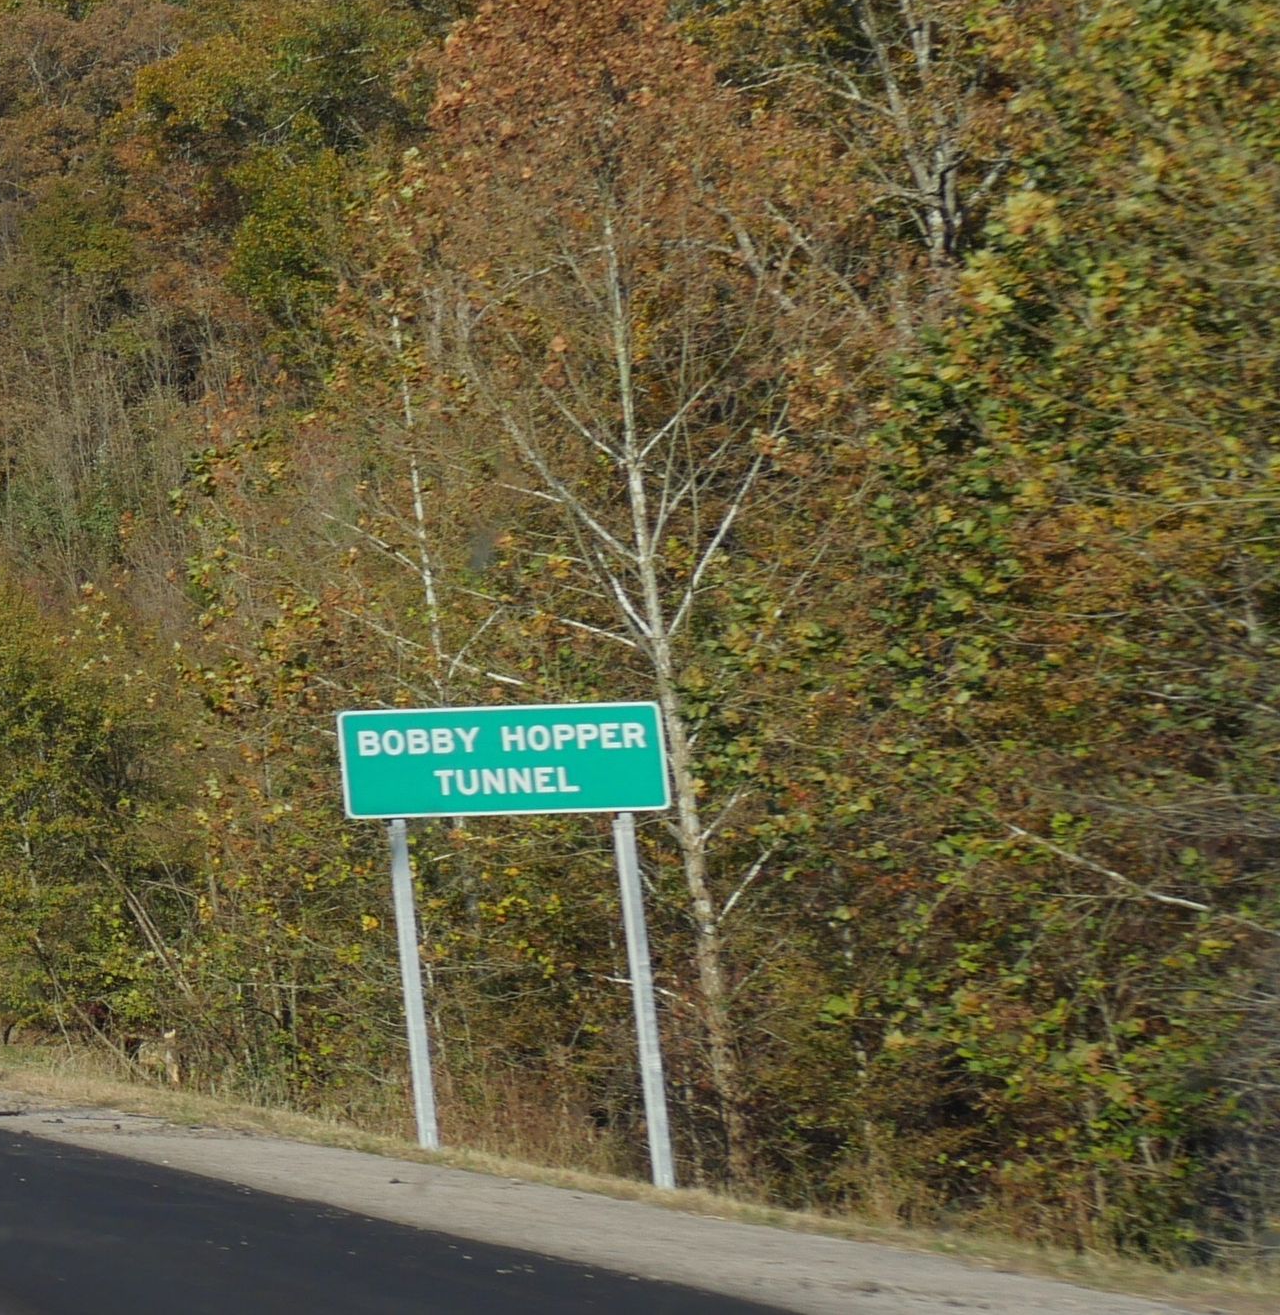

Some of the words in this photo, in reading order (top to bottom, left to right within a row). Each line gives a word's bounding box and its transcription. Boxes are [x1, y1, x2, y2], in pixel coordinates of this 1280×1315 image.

[357, 726, 480, 757] BOBBY
[500, 722, 647, 752] HOPPER
[433, 766, 581, 796] TUNNEL
